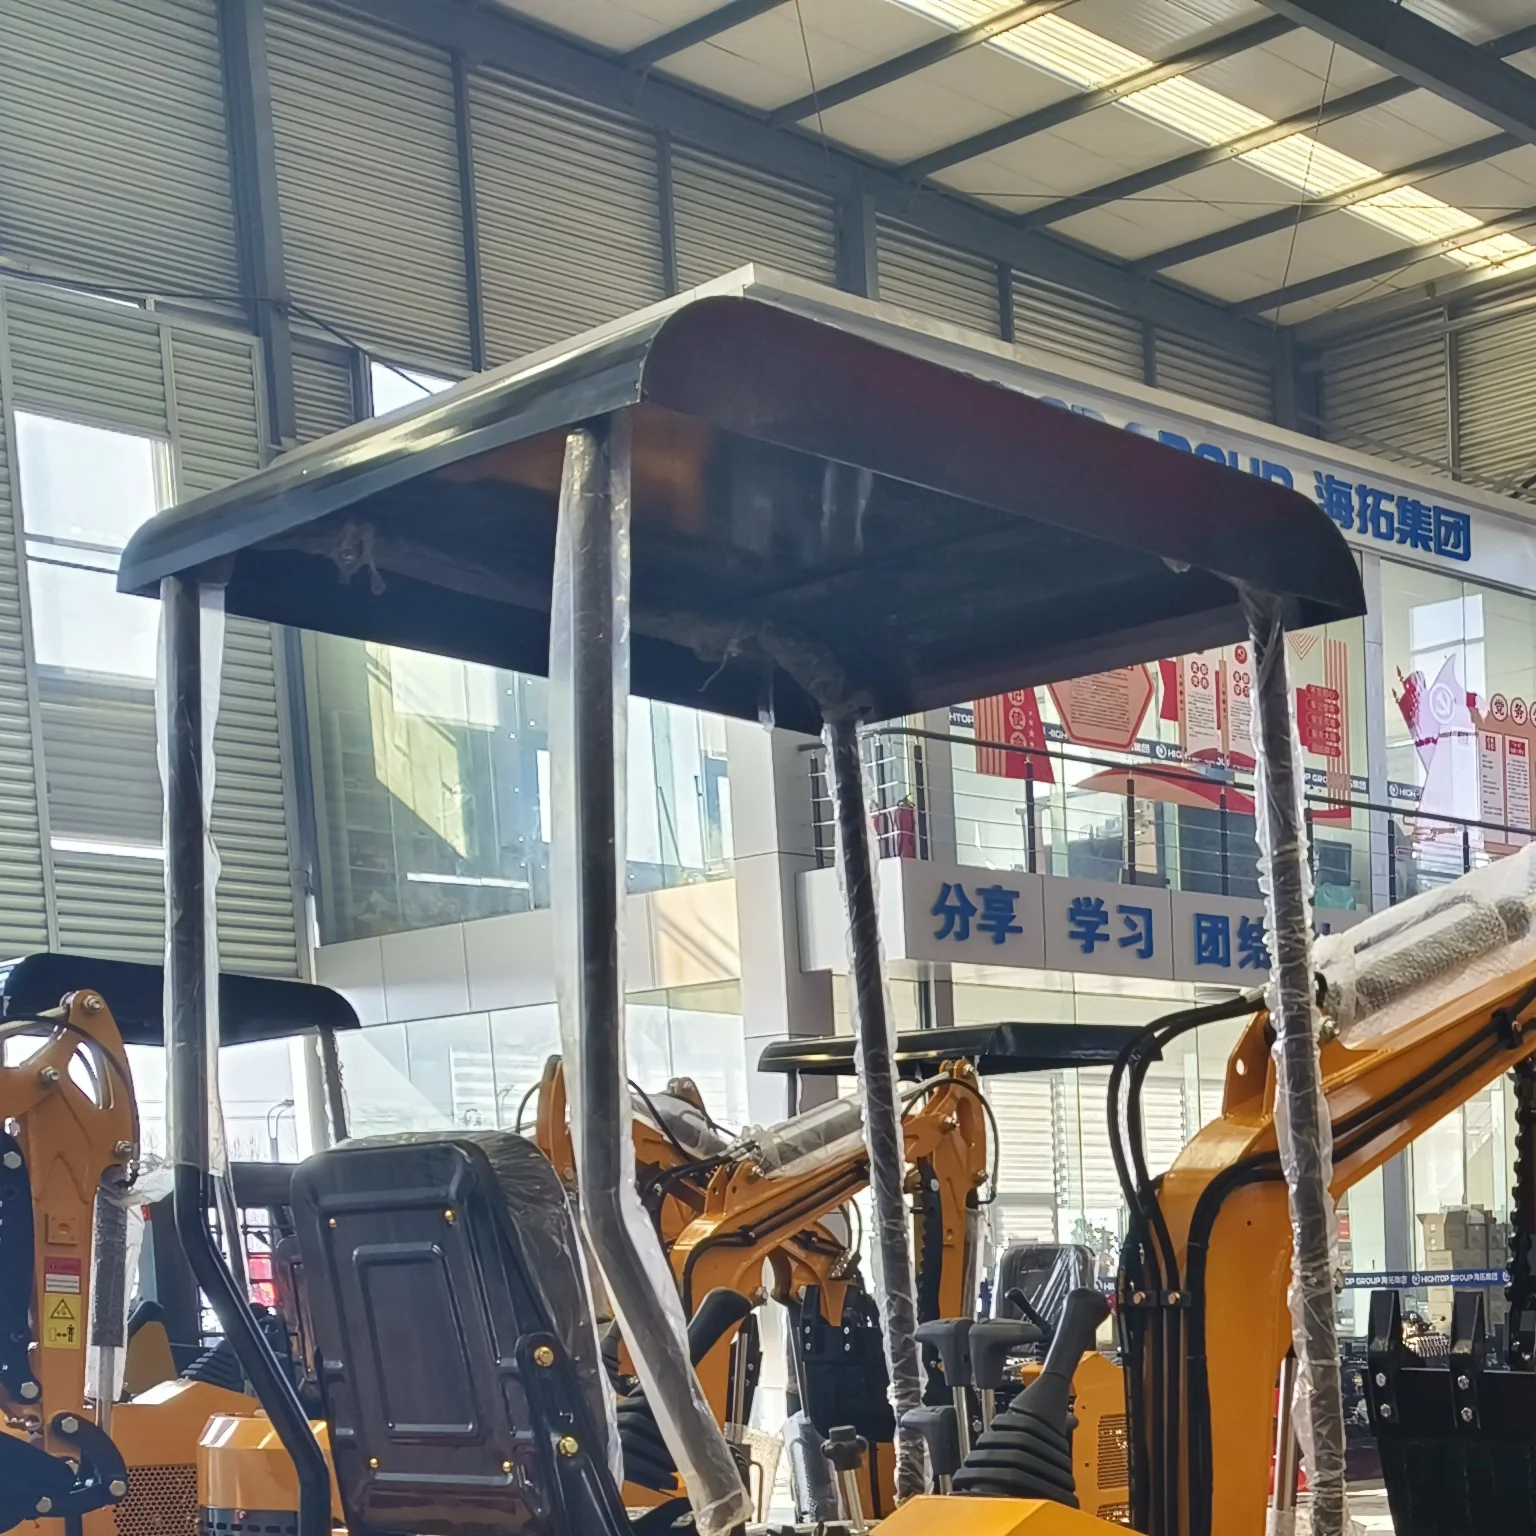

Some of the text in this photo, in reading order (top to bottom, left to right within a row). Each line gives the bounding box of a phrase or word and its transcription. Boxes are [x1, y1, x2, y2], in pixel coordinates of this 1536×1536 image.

[1313, 471, 1472, 562] 海拓集团
[931, 882, 1024, 946] 分享
[1067, 895, 1155, 960] 学习
